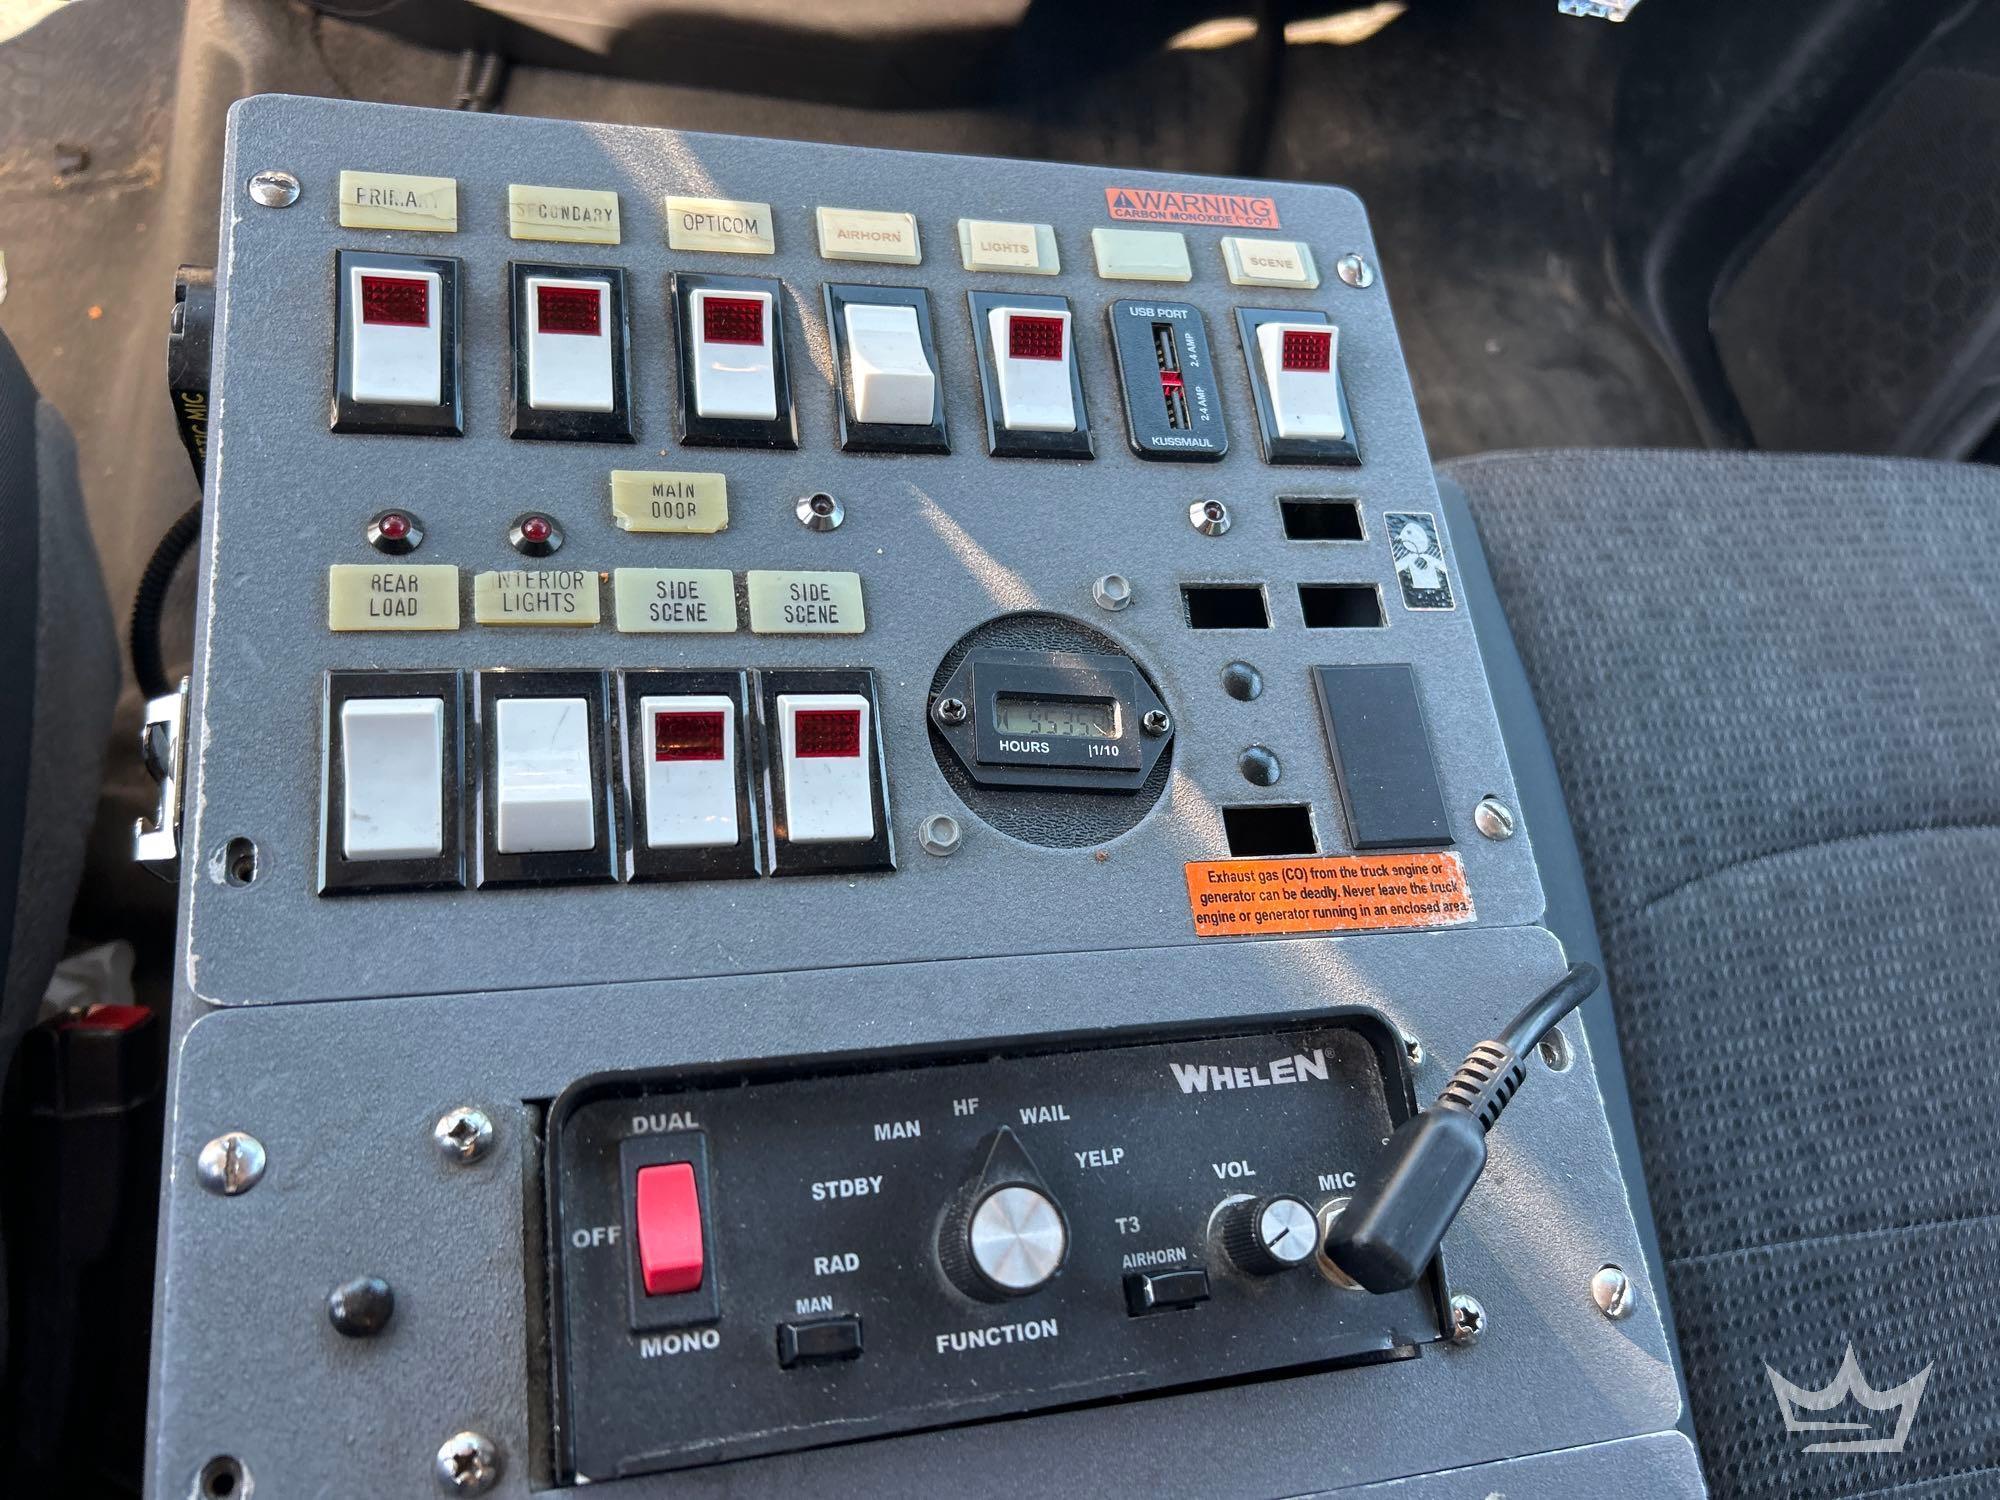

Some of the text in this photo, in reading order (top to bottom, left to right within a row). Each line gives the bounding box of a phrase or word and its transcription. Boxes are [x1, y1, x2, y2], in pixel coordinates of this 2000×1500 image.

[1134, 191, 1271, 218] WARNING
[683, 213, 759, 235] OPTICOM
[1114, 208, 1167, 220] CARBON
[1170, 211, 1233, 223] MONOXIDE
[836, 229, 902, 243] AIRHORN
[980, 241, 1030, 254] LIGHTS
[1248, 256, 1295, 270] SCENE
[1129, 306, 1189, 319] USB PORT
[1184, 332, 1197, 353] AMP
[181, 392, 209, 421] MIC
[1195, 386, 1208, 407] AMP
[1151, 436, 1214, 448] KUSSMAUL
[652, 482, 696, 499] MAIN
[651, 501, 697, 519] DOOR
[370, 574, 419, 593] REAR
[491, 570, 585, 590] NTERIOR
[656, 581, 699, 600] SIDE
[502, 591, 576, 613] LIGHTS
[790, 583, 831, 602] SIDE
[369, 597, 419, 617] LOAD
[649, 603, 708, 622] SCENE
[784, 604, 840, 624] SCENE
[999, 740, 1050, 754] HOURS
[1207, 863, 1443, 885] Exhaust gas (CO) from the truck engine or
[1200, 881, 1459, 907] generator can be deadly. Never leave the truck
[1196, 900, 1470, 927] engine or generator running in an enclosed area.
[1168, 1048, 1330, 1094] WHELEN
[952, 1097, 980, 1117] HF
[1019, 1104, 1071, 1126] WAIL
[631, 1112, 699, 1134] DUAL
[873, 1120, 921, 1141] MAN
[1074, 1147, 1125, 1169] YELP
[1212, 1160, 1256, 1180] VOL
[811, 1175, 883, 1201] STDBY
[1318, 1171, 1357, 1192] MIC
[1115, 1216, 1141, 1235] T3
[571, 1225, 622, 1248] OFF
[813, 1252, 860, 1277] RAD
[1121, 1247, 1188, 1269] AIRHORN
[795, 1295, 833, 1315] MAN
[639, 1329, 721, 1359] MONO
[935, 1318, 1059, 1354] FUNCTION
